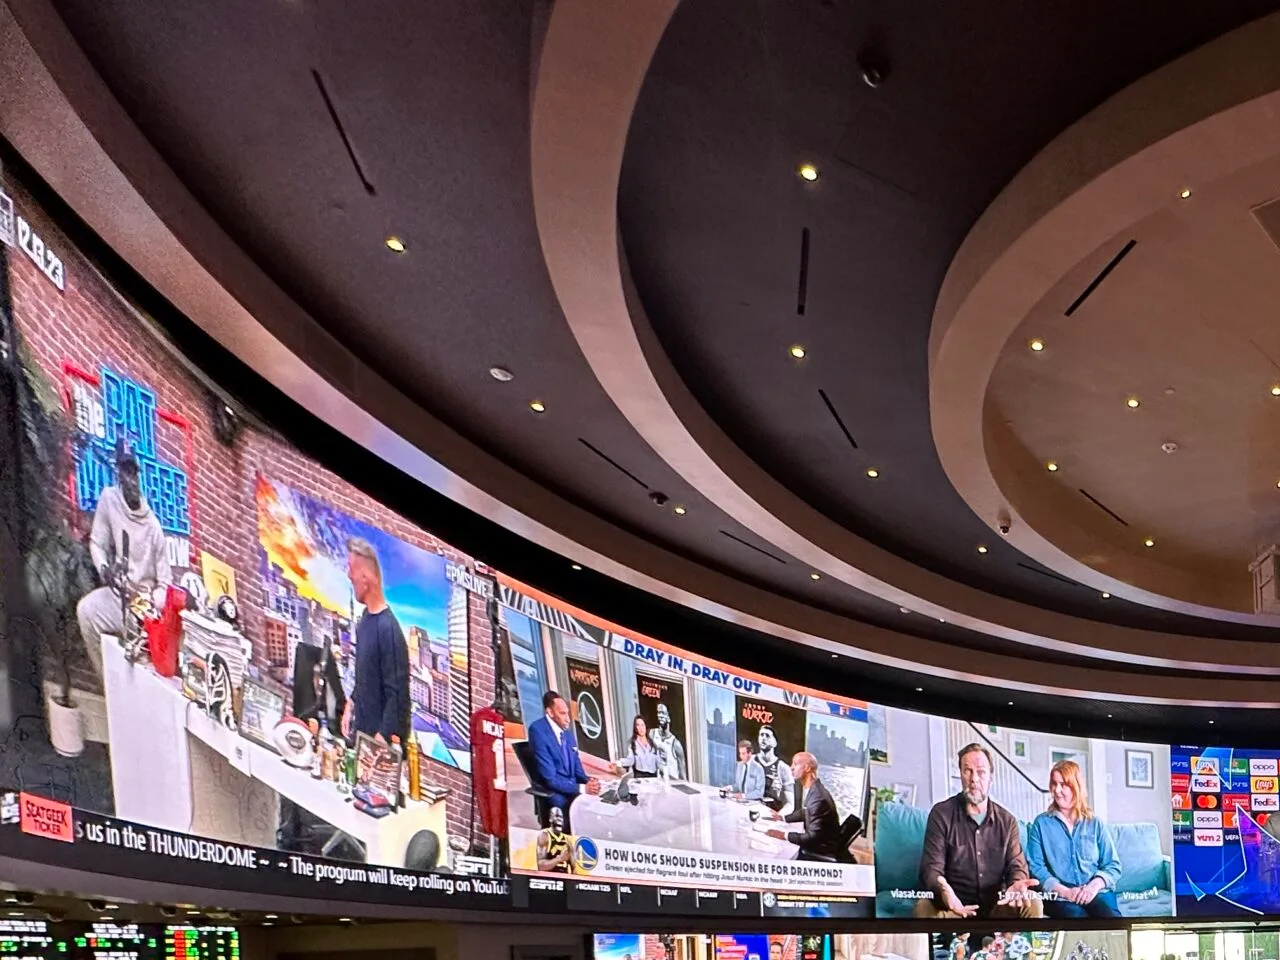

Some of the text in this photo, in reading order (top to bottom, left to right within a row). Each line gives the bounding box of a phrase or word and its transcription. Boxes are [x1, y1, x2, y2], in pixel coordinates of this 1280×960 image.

[102, 367, 155, 458] PAT
[623, 639, 664, 664] DRAY
[668, 655, 688, 674] IN,
[692, 663, 730, 685] DRAY
[732, 677, 762, 694] OUT
[1195, 779, 1217, 788] FedEx
[1254, 798, 1276, 807] FedEx
[26, 800, 68, 827] SEATGEEK
[1196, 816, 1219, 824] oppo
[1217, 834, 1222, 842] 2
[87, 825, 103, 843] us
[105, 821, 121, 845] in
[123, 827, 146, 851] the
[148, 831, 257, 869] THUNDERDOME
[290, 856, 313, 877] The
[315, 862, 366, 884] progrum
[368, 868, 388, 885] will
[390, 872, 417, 890] keep
[419, 876, 454, 895] rolling
[455, 880, 470, 892] on
[605, 848, 843, 879] HOW LONG SHOULD SUSPENSION BE FOR DRAYMOND?
[891, 889, 934, 900] viasat.com
